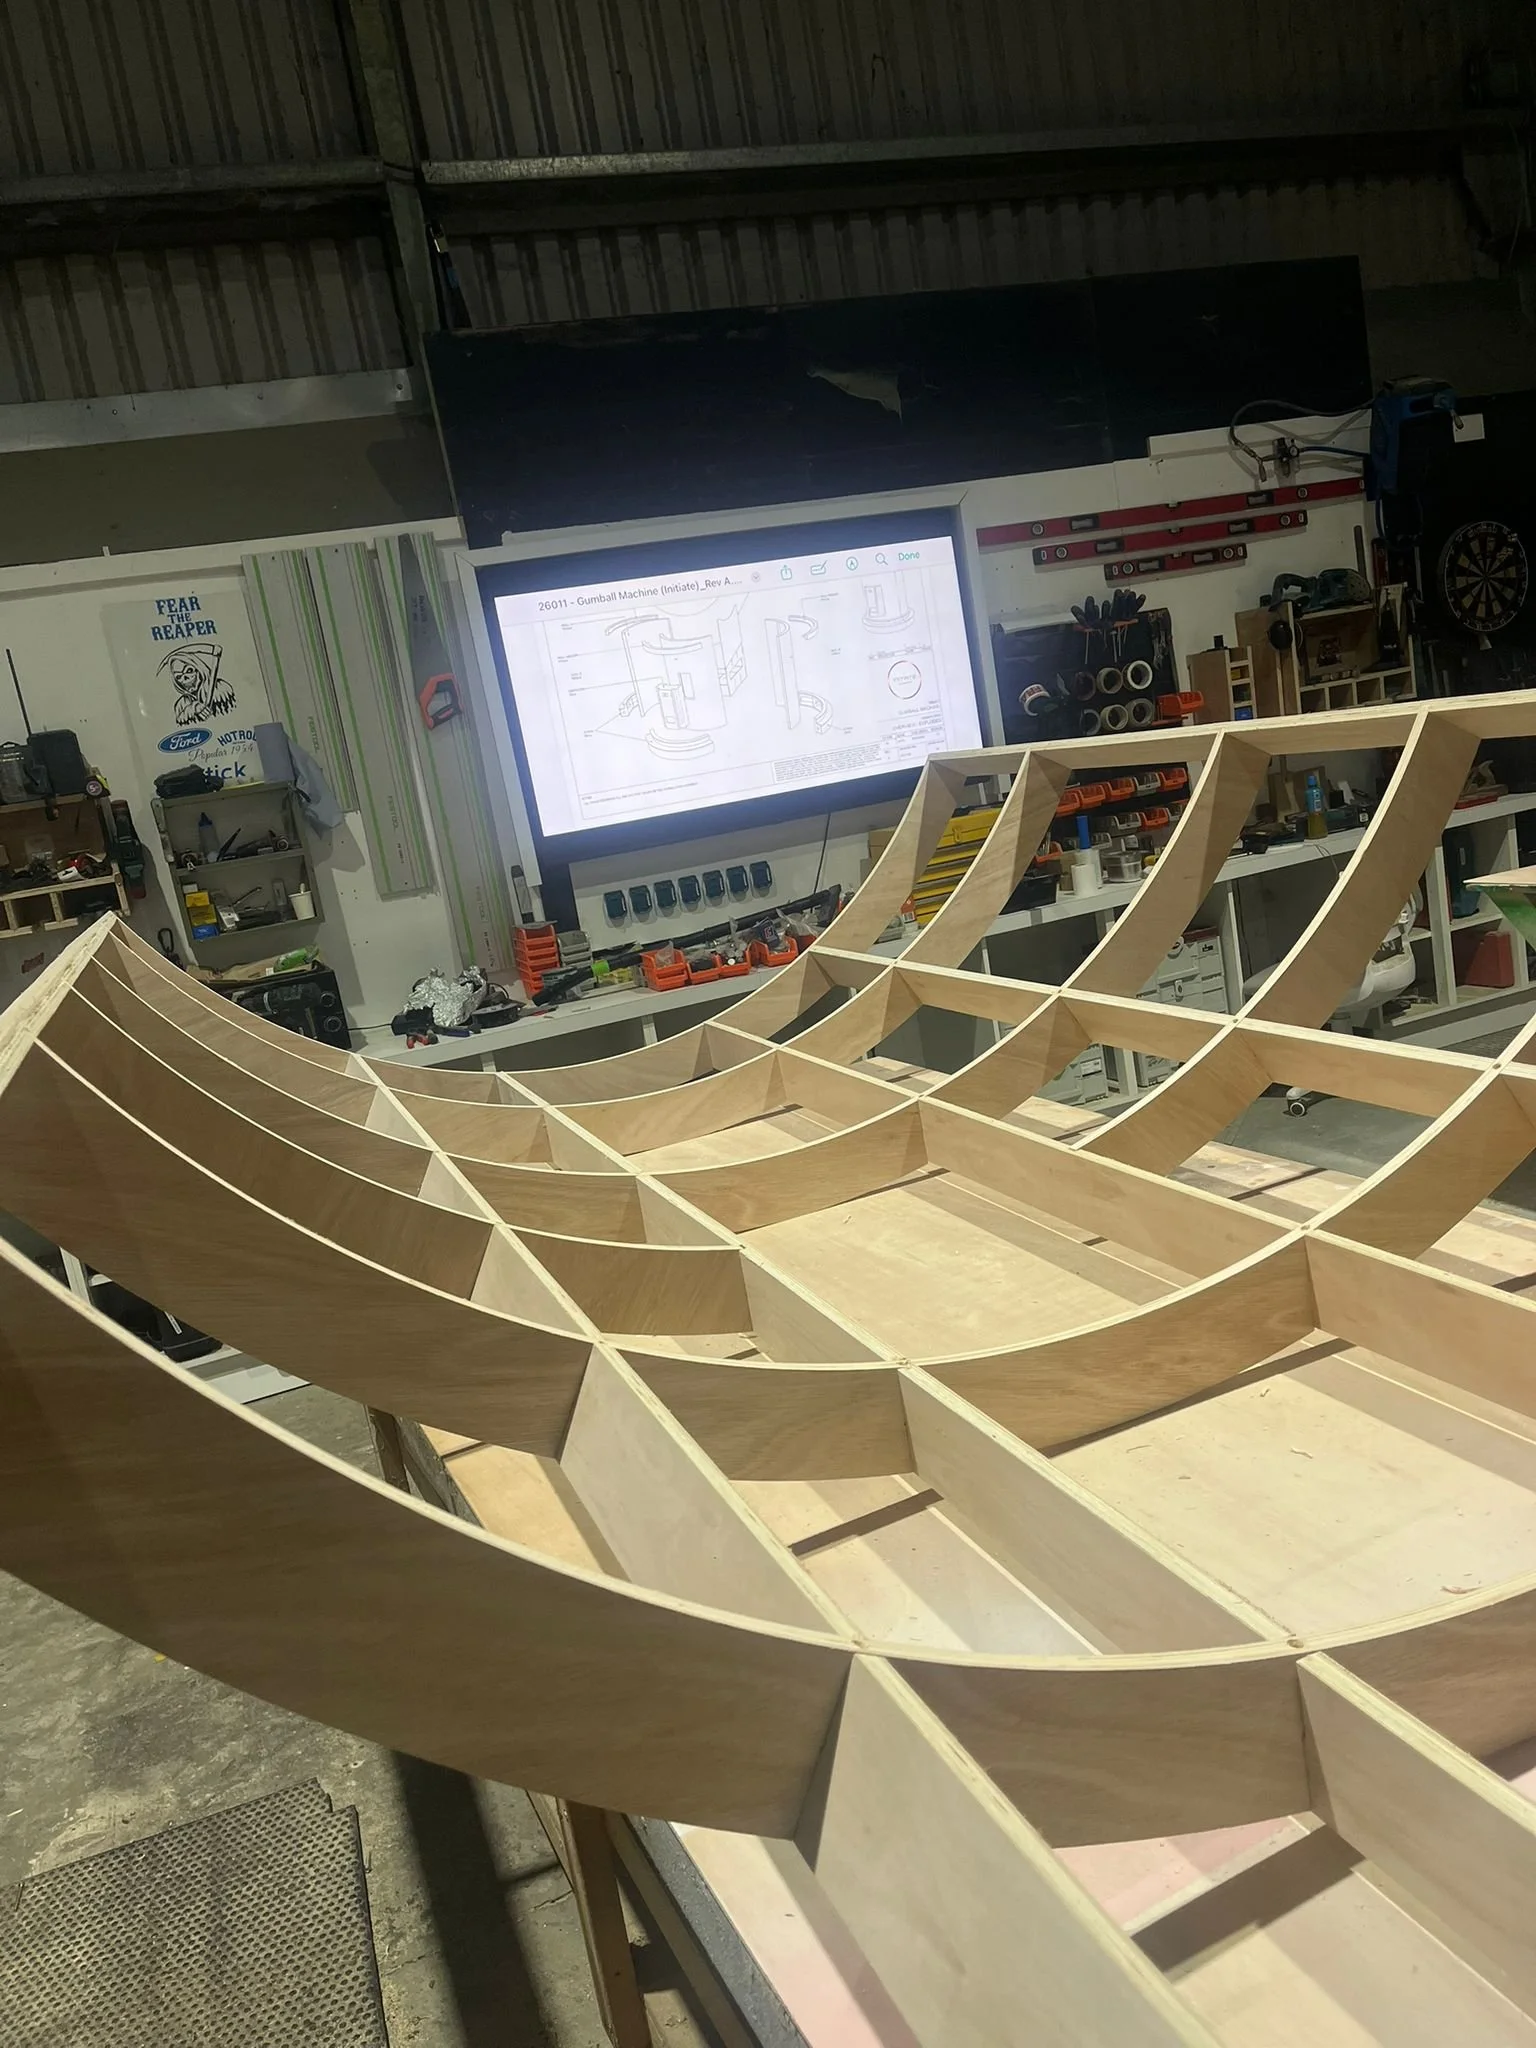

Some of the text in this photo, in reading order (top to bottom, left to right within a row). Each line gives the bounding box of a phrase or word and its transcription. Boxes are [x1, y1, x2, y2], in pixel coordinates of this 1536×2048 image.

[898, 551, 920, 561] Done
[155, 595, 201, 615] FEAR
[538, 599, 568, 611] 26011
[576, 591, 617, 606] Gumball
[619, 587, 659, 601] Machine
[167, 613, 192, 624] THE
[151, 620, 217, 641] REAPER
[169, 732, 201, 750] Ford
[188, 743, 254, 763] Popular 1954
